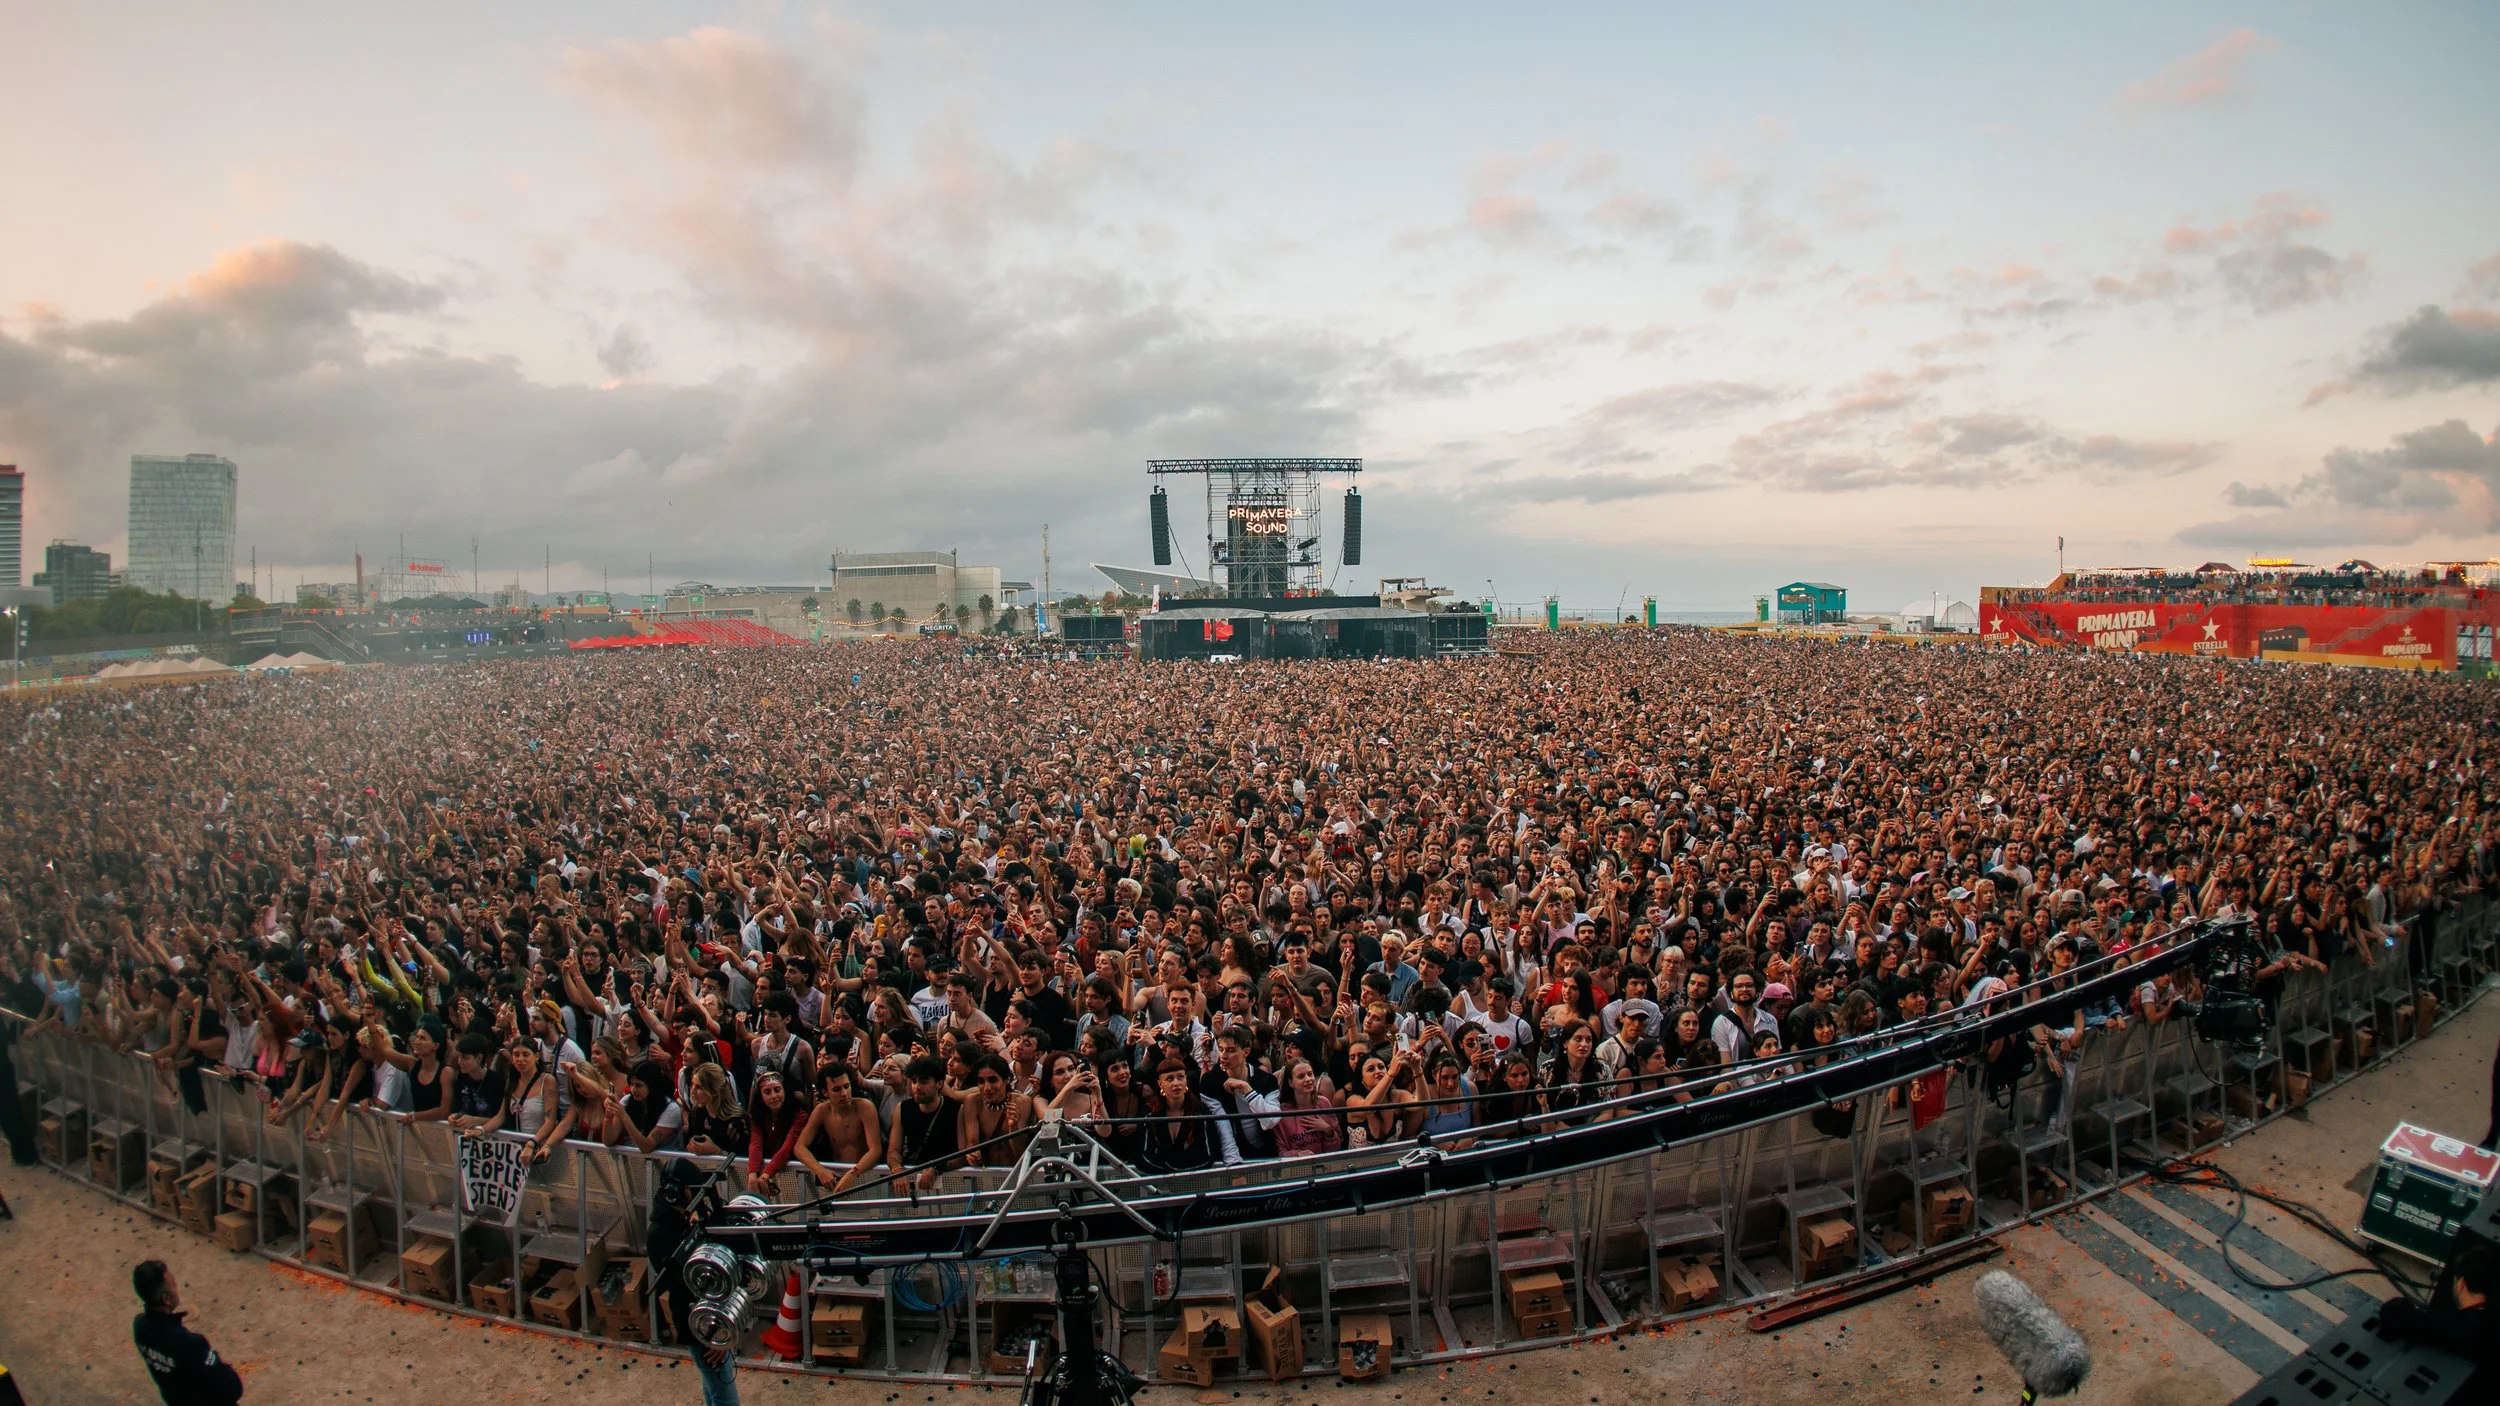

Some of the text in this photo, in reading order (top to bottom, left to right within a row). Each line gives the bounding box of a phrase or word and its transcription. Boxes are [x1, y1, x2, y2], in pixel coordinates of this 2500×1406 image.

[1229, 507, 1303, 522] PRIMAVERA
[1246, 521, 1288, 534] SOUND
[2077, 609, 2156, 633] PRIMAVERA
[1983, 631, 2010, 642] ESTRELLA
[2093, 630, 2140, 649] SOUND
[2193, 640, 2228, 651] ESTRELLA
[2382, 641, 2433, 656] PRIMAVERA
[461, 1157, 522, 1193] PEOPLE
[1204, 1205, 1258, 1220] Scanner
[1264, 1197, 1293, 1212] Elite
